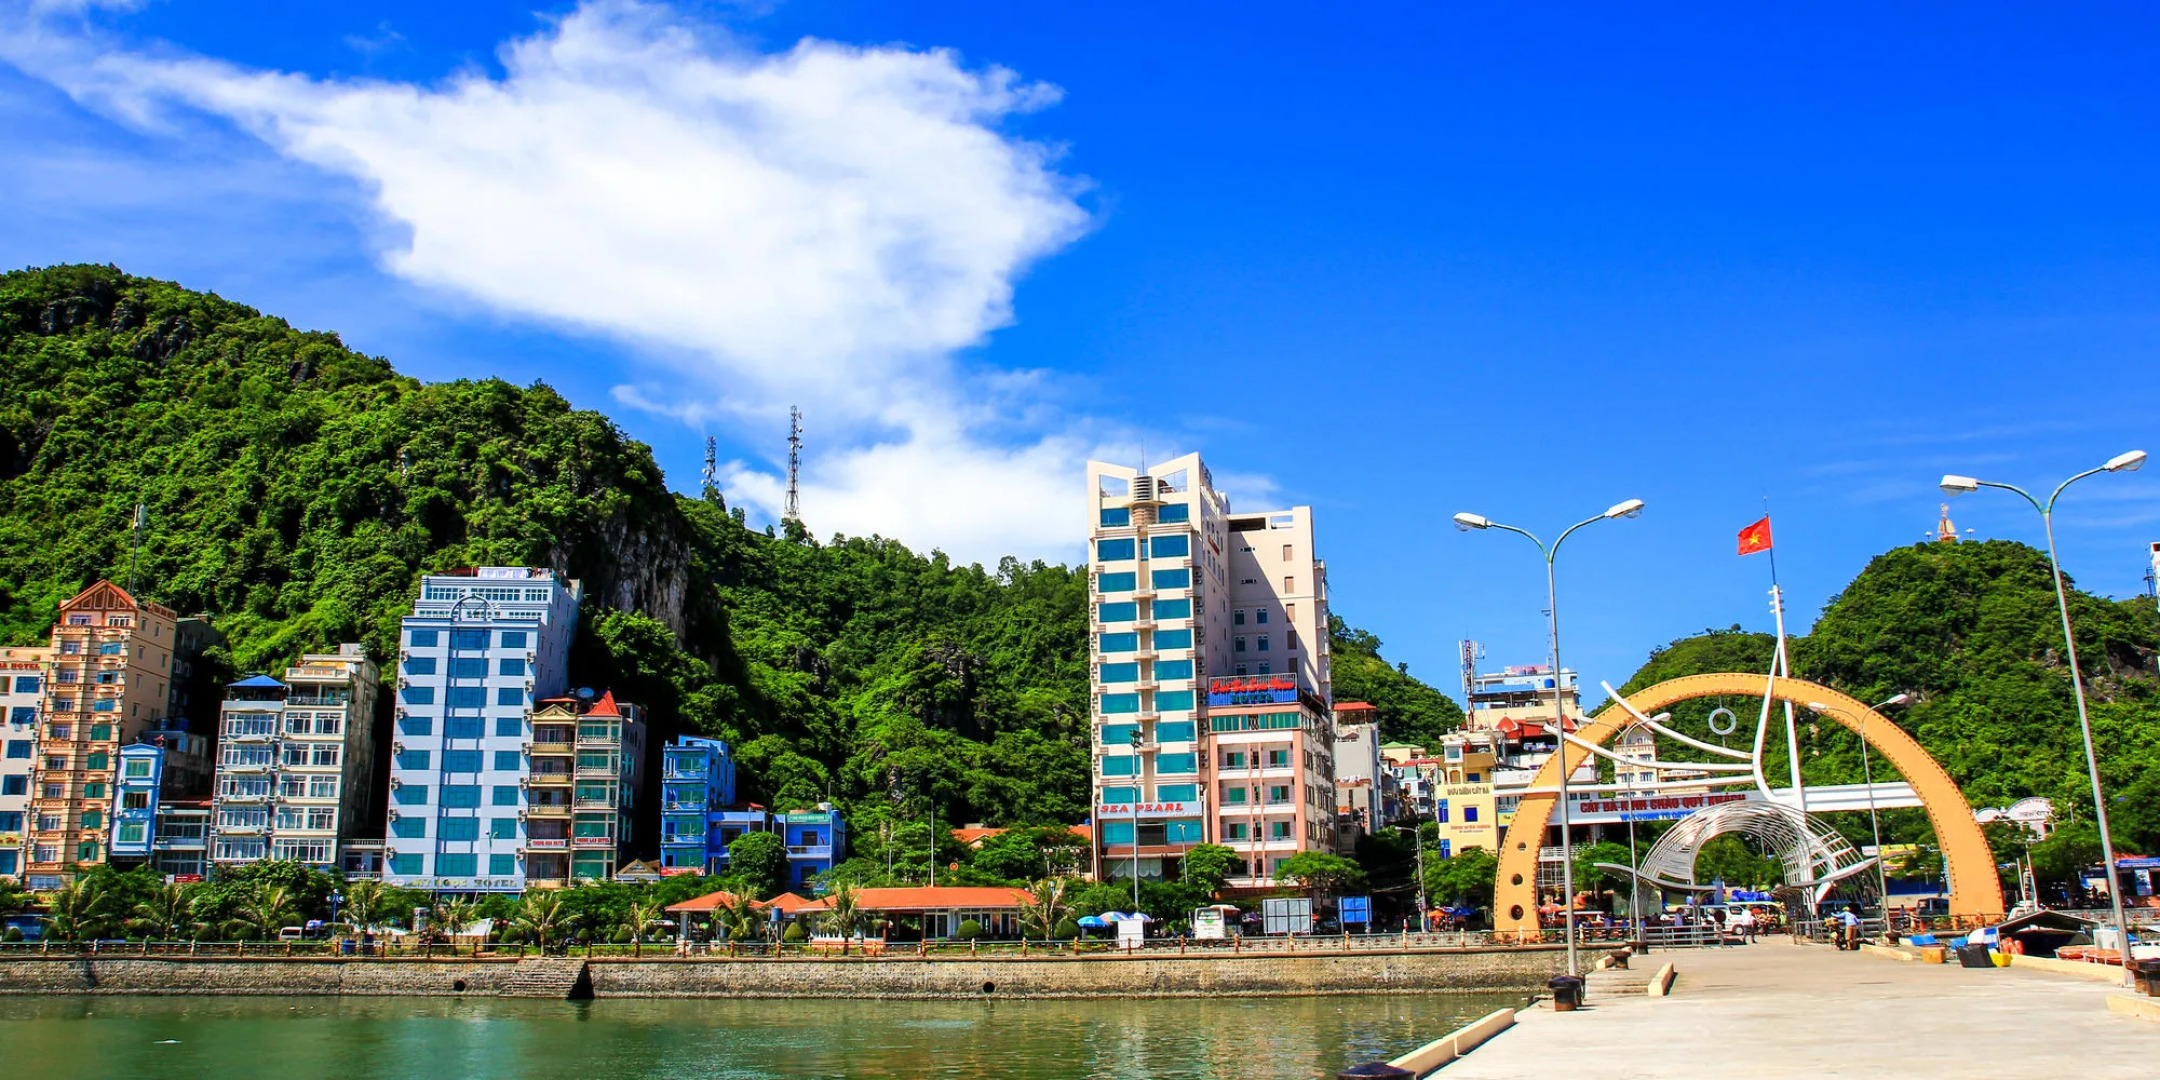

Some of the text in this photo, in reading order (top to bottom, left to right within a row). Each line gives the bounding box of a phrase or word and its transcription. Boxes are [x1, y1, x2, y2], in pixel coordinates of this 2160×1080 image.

[1232, 693, 1273, 704] HOTEL
[1100, 803, 1183, 813] SEA PEARL
[1580, 800, 1599, 813] CÁT
[1650, 796, 1679, 809] CHÀO
[1683, 793, 1703, 808] QUÝ
[474, 879, 517, 887] HOTEL
